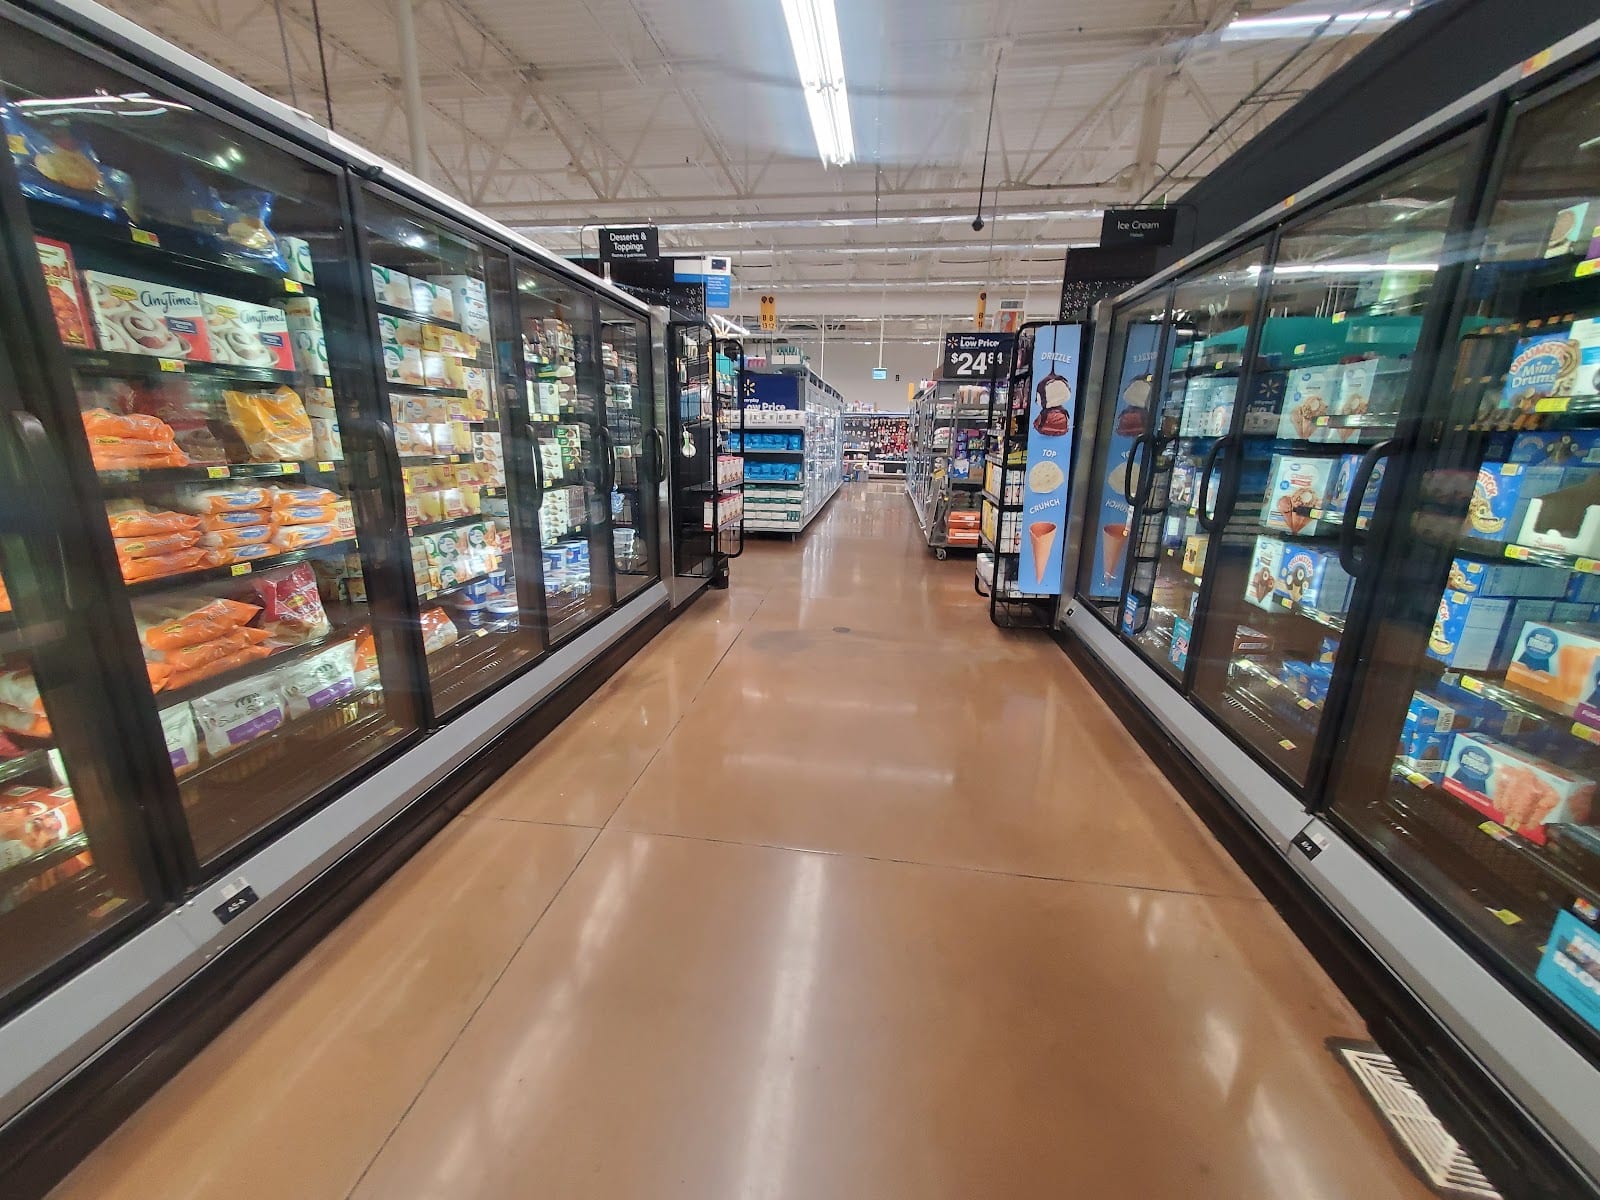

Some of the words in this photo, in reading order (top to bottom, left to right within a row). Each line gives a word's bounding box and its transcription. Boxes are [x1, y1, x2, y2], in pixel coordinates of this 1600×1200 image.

[1117, 220, 1130, 230] Ice
[1131, 220, 1160, 230] Cream
[609, 232, 639, 242] Desserts
[640, 231, 647, 241] &
[613, 242, 644, 252] Toppings
[960, 339, 977, 347] Low
[978, 339, 999, 348] Price
[1041, 351, 1072, 364] DRIZZLE
[1522, 360, 1556, 378] Mini
[1511, 374, 1556, 388] Drums
[762, 402, 786, 411] Price
[1042, 449, 1057, 458] TOP
[1029, 498, 1061, 514] CRUNCH
